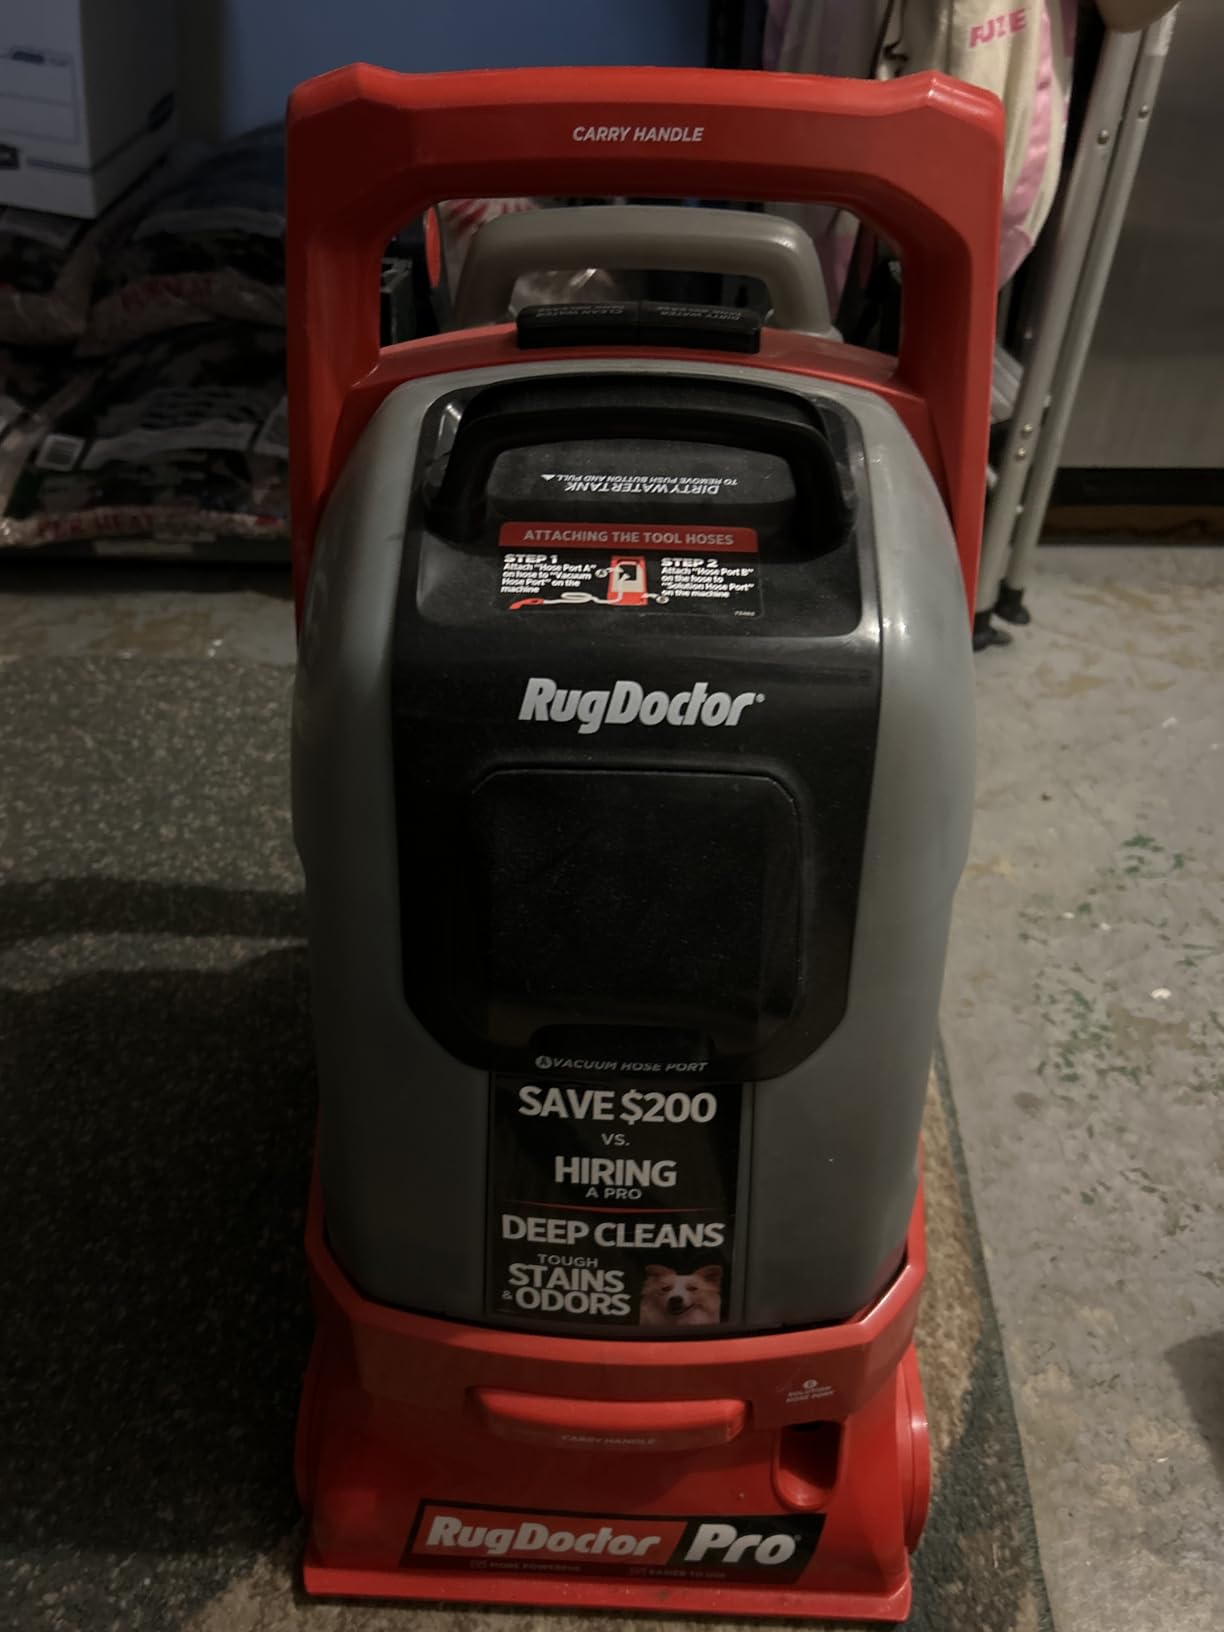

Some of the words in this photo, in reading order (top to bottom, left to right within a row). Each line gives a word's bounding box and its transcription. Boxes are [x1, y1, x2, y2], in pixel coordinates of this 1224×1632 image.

[572, 126, 631, 142] CARRY
[632, 126, 705, 142] HANDLE
[607, 475, 649, 483] BUTTON
[649, 476, 678, 484] PUSH
[679, 477, 723, 485] REMOVE
[723, 478, 738, 486] TO
[564, 482, 610, 492] TANK
[611, 483, 669, 494] WATER
[669, 484, 720, 495] DIRTY
[523, 529, 608, 542] ATTACHING
[612, 531, 640, 543] THE
[642, 532, 683, 544] TOOL
[685, 533, 735, 545] HOSES
[504, 554, 548, 564] STEP
[549, 554, 559, 564] 1
[661, 557, 705, 568] STEP
[706, 558, 720, 568] 2
[503, 563, 534, 571] Attach
[563, 563, 583, 572] Port
[661, 566, 692, 575] Attach
[720, 567, 741, 576] Port
[515, 571, 538, 579] hose
[674, 575, 690, 583] the
[690, 575, 713, 583] hose
[713, 575, 725, 583] to
[564, 579, 581, 587] the
[704, 582, 729, 591] Hose
[500, 585, 541, 593] machine
[674, 589, 691, 597] the
[691, 590, 731, 598] machine
[518, 677, 756, 734] RugDoctor
[552, 1057, 617, 1071] VACUUM
[619, 1061, 662, 1072] HOSE
[665, 1061, 709, 1073] PORT
[518, 1084, 616, 1122] SAVE
[619, 1088, 718, 1126] $200
[553, 1155, 678, 1188] HIRING
[584, 1187, 599, 1199] A
[603, 1187, 643, 1201] PRO
[501, 1213, 590, 1246] DEEP
[593, 1222, 727, 1249] CLEANS
[536, 1253, 599, 1268] TOUGH
[508, 1262, 625, 1293] STAINS
[501, 1289, 513, 1301] &
[515, 1286, 632, 1316] ODORS
[425, 1515, 662, 1557] RugDoctor
[683, 1523, 798, 1565] Pro
